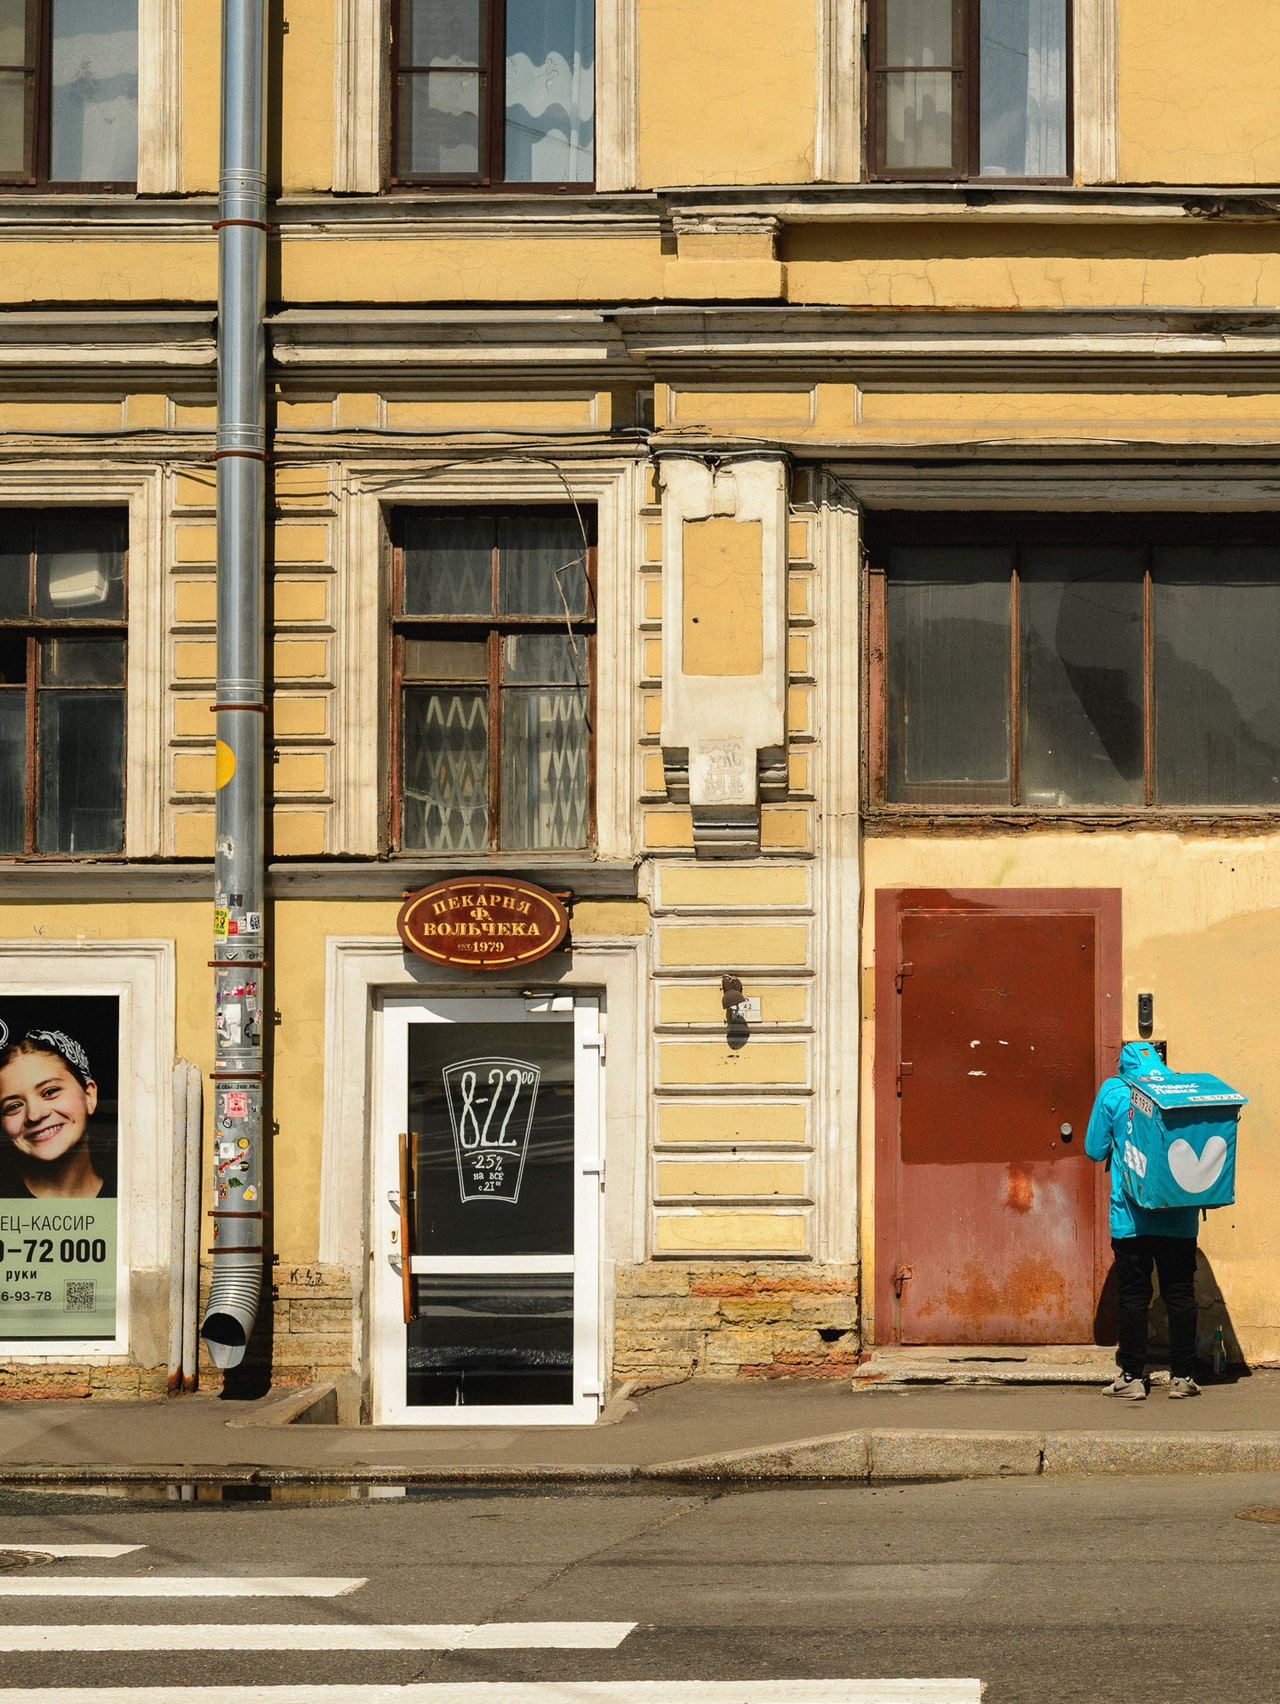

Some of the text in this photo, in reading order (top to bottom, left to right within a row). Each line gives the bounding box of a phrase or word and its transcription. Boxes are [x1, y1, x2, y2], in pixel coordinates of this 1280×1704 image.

[432, 894, 531, 915] ПЕКАРНЯ
[470, 907, 493, 921] Ф.
[423, 922, 541, 936] ВОЛЬЧЕКА
[473, 941, 504, 953] 1979
[471, 1154, 503, 1171] -25%
[60, 1239, 106, 1262] 000
[6, 1270, 37, 1282] руки
